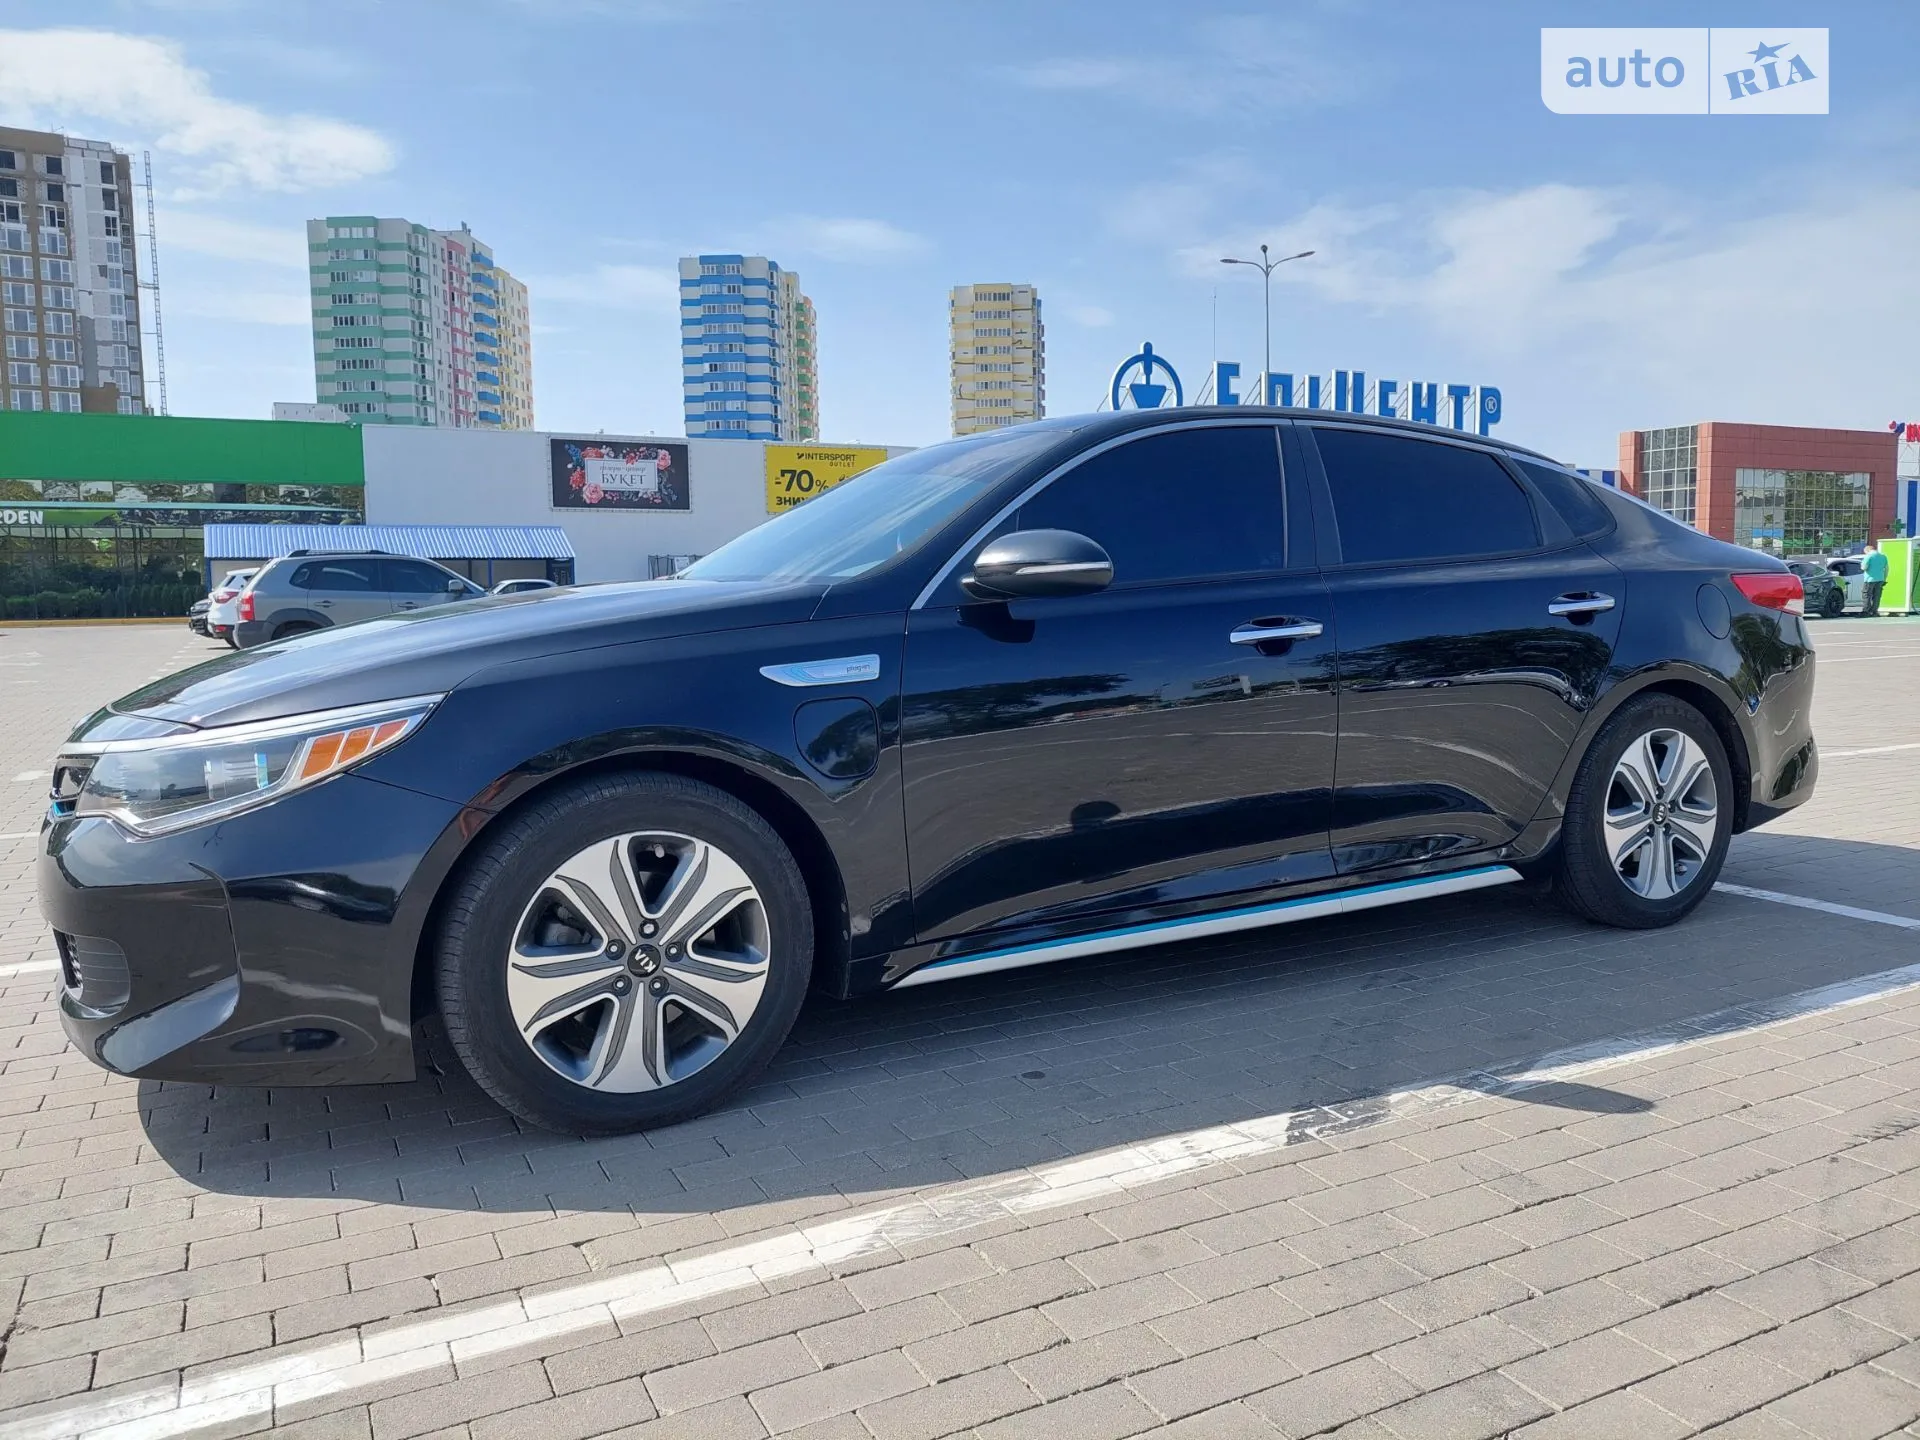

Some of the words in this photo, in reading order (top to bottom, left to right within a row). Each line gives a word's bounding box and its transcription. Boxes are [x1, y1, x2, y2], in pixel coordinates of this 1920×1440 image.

[804, 453, 856, 461] INTERSPORT
[602, 473, 647, 487] БУКЕТ
[0, 509, 44, 525] DEN
[634, 948, 657, 973] KIA
